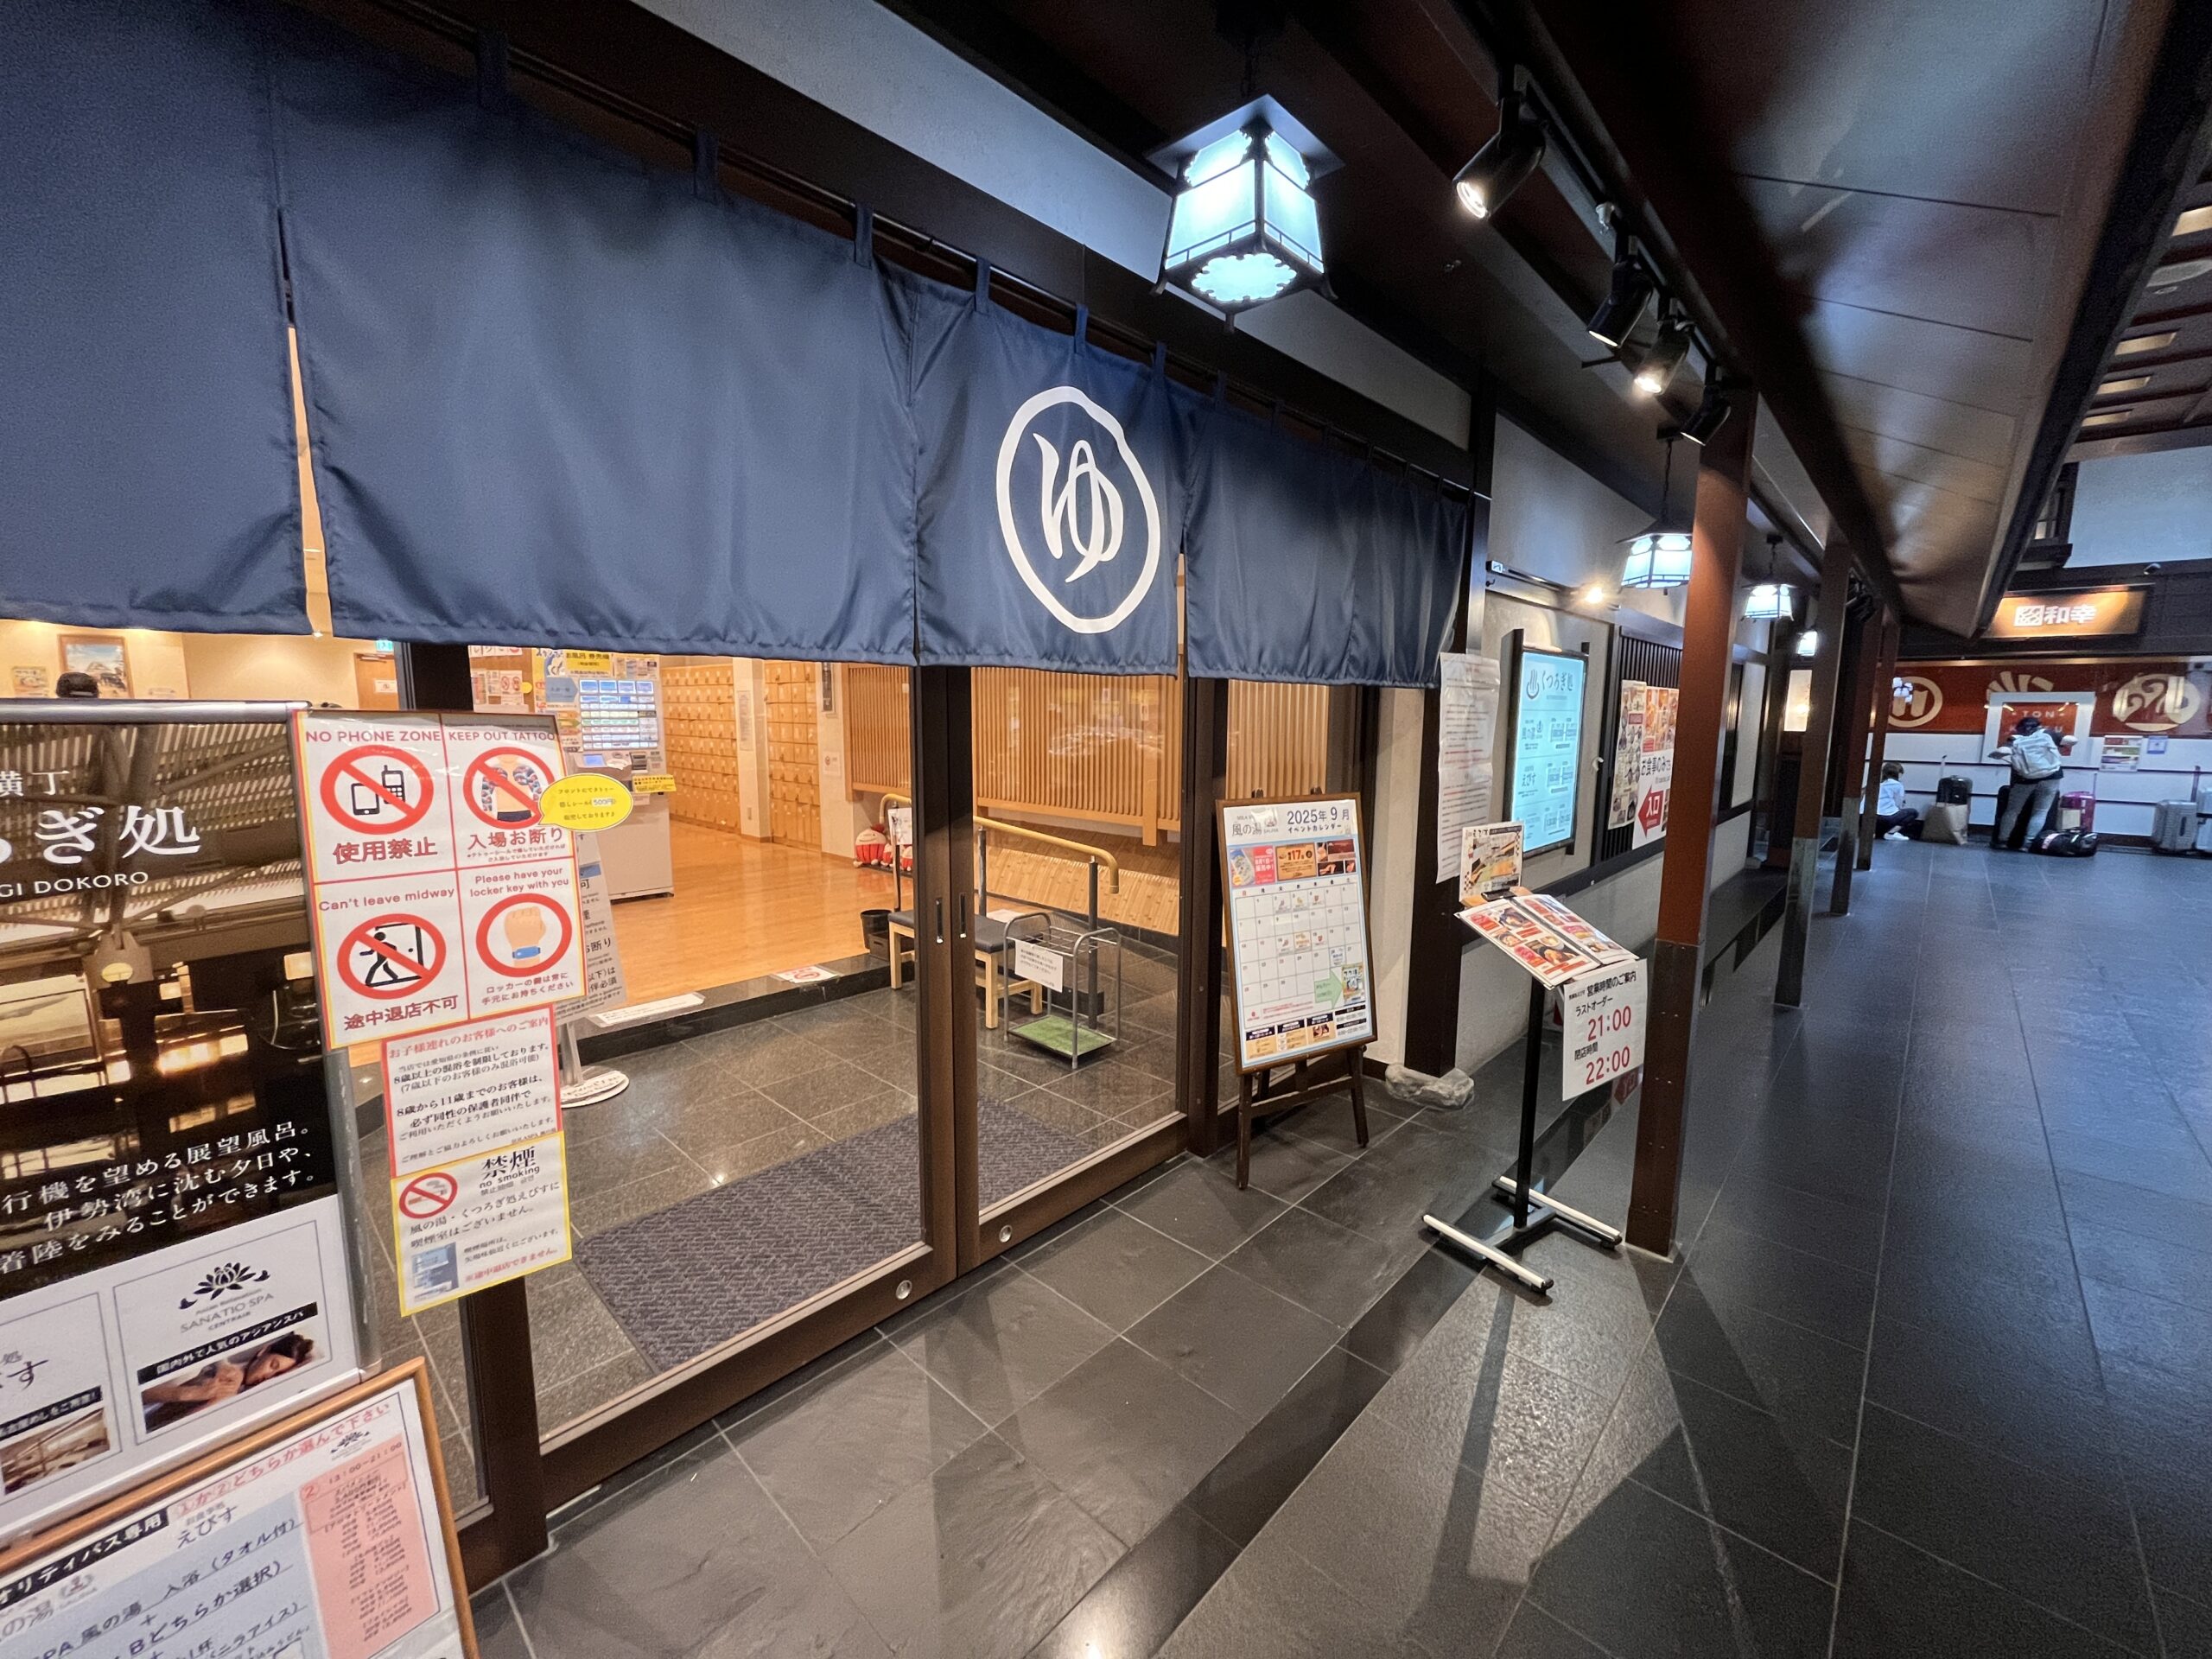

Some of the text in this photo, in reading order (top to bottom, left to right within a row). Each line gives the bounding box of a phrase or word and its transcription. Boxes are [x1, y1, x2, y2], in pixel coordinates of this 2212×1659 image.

[306, 731, 442, 742] NO PHONE ZONE
[449, 731, 555, 741] KEEP OUT TATTOO
[1645, 795, 1660, 818] 入口
[0, 805, 200, 864] ぎ処
[467, 827, 563, 851] 入場お断り
[333, 836, 438, 865] 使用禁止
[35, 871, 149, 894] DOKORO
[469, 877, 569, 898] locker key with you
[475, 868, 563, 885] Please have your
[319, 887, 454, 912] Can't leave midway
[481, 979, 574, 1006] 手元にお持ちください
[588, 976, 617, 994] 伴必須
[1586, 971, 1637, 997] 営業時間のご案内
[344, 995, 458, 1031] 途中退店不可
[1575, 995, 1613, 1017] ラストオーダー
[389, 1017, 549, 1058] お子様連れのお客様へのご案内
[1587, 1006, 1631, 1041] 21:00
[1574, 1041, 1599, 1061] 閉店時間
[1586, 1046, 1630, 1085] 22:00
[410, 1090, 531, 1128] 必ず同性の保護者同伴で
[2, 1122, 308, 1215] 行機を望める展望風呂。
[480, 1166, 540, 1189] no smoking
[481, 1146, 536, 1181] 禁煙
[44, 1147, 311, 1231] 伊勢湾に沈む夕日や、
[0, 1168, 315, 1274] 着陸をみることができます。
[410, 1205, 534, 1249] 喫煙室はございません。
[180, 1293, 275, 1333] SANATIO SPA
[177, 1506, 220, 1549] えびす
